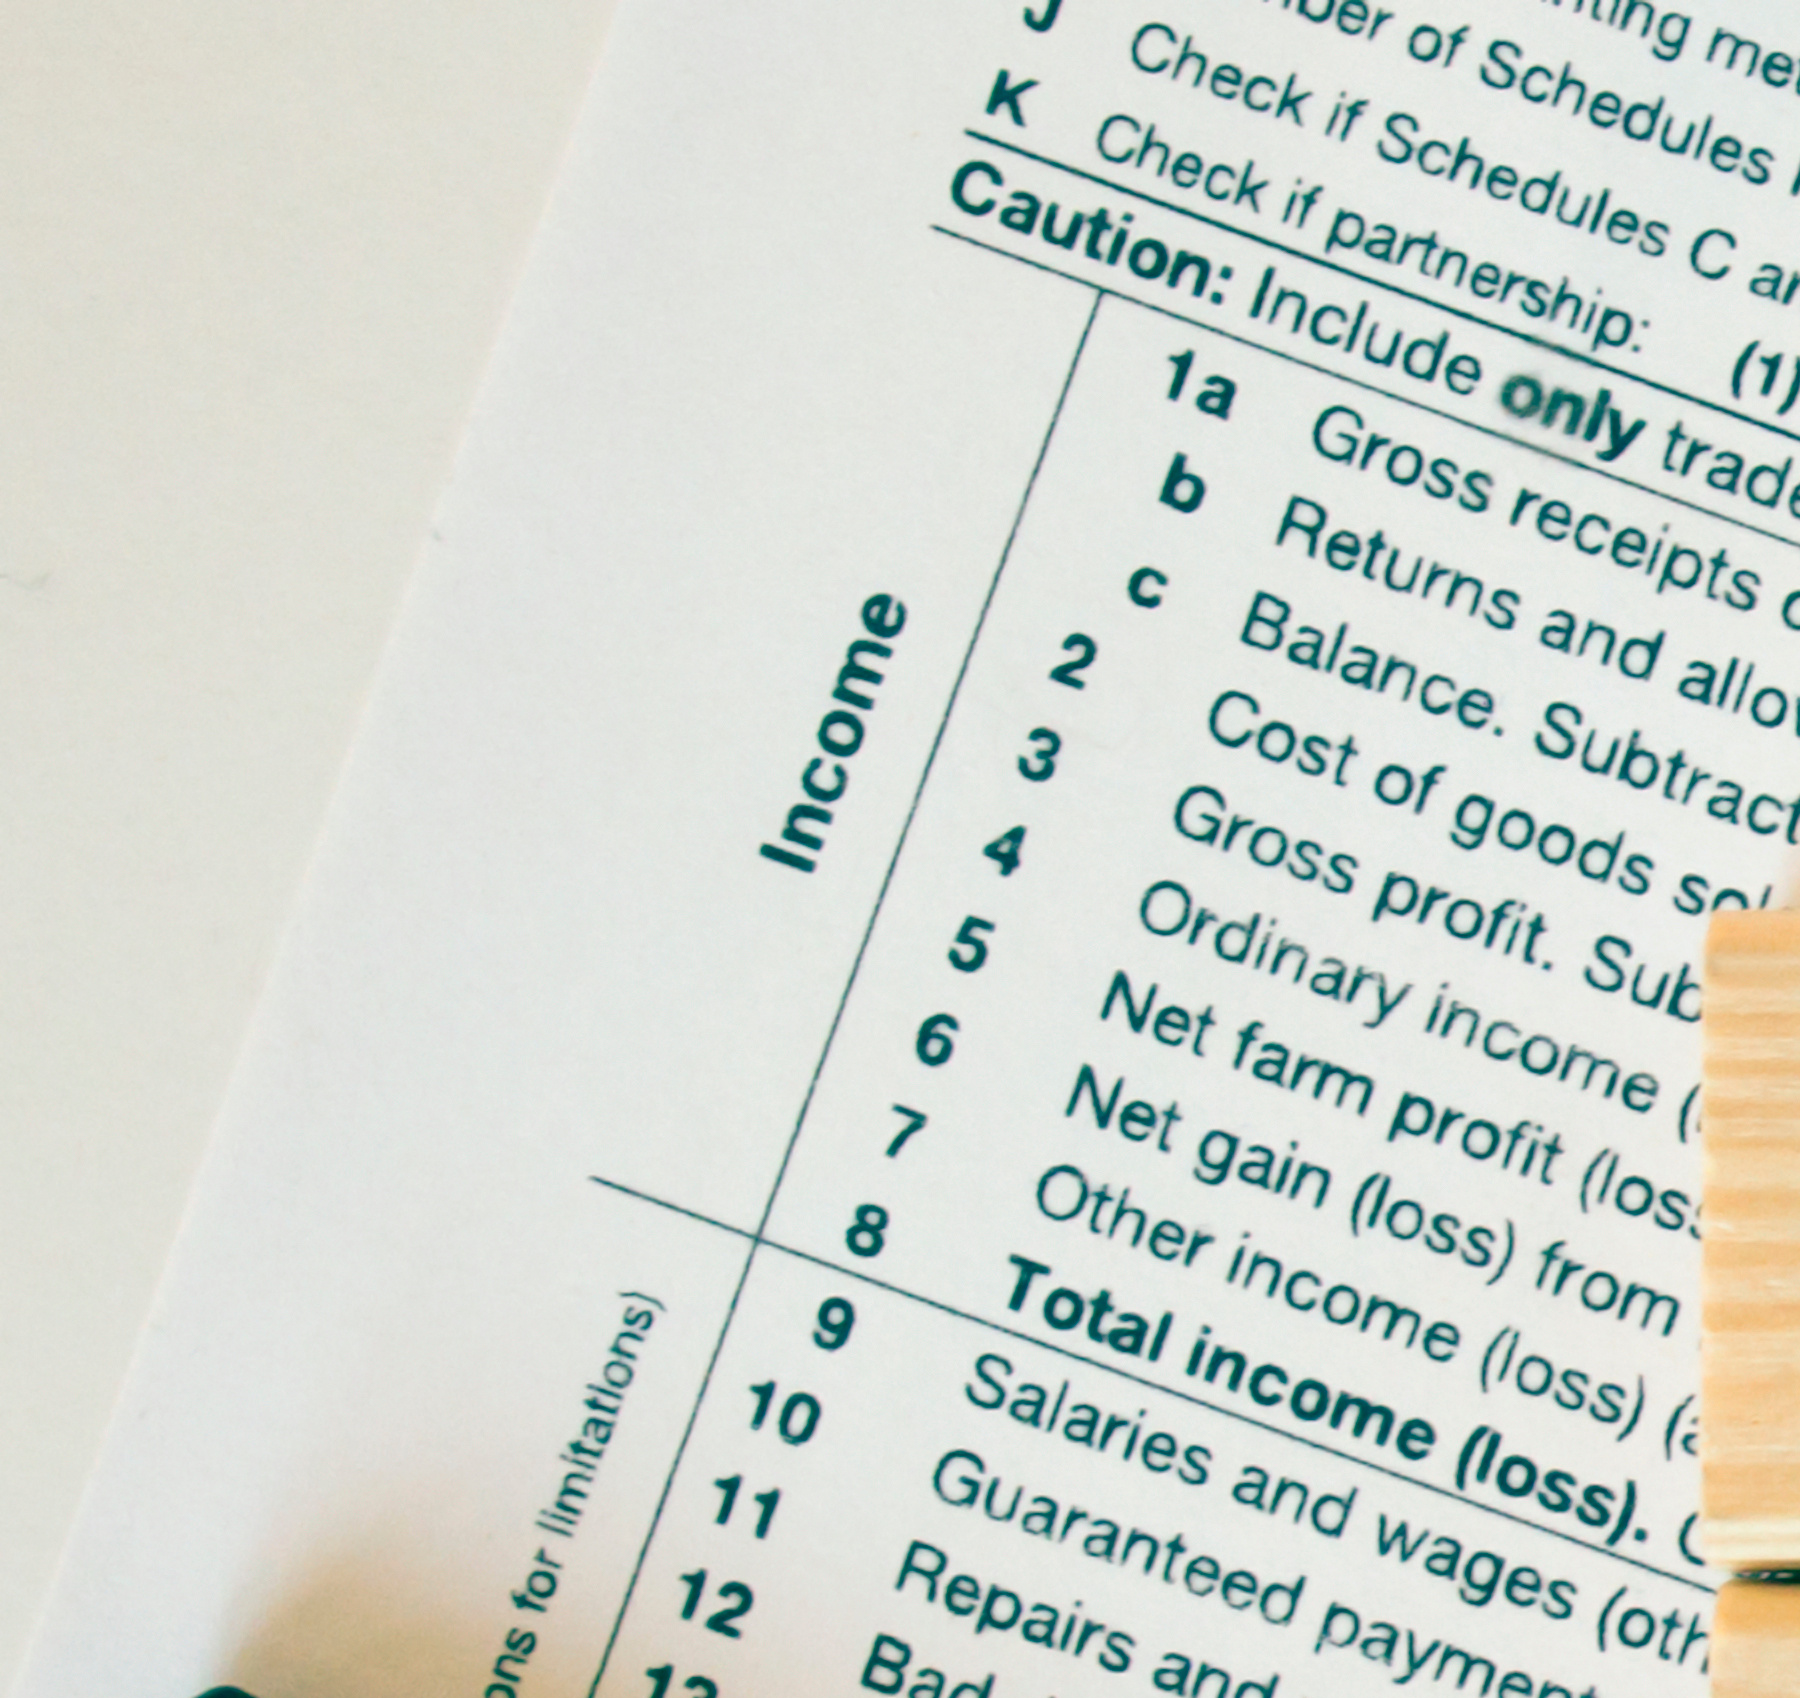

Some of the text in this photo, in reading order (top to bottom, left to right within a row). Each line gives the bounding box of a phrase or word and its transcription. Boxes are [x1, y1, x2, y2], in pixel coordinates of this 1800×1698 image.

[983, 67, 1642, 354] K Check if partnership:
[1406, 22, 1472, 69] of
[1478, 38, 1776, 187] Schedules
[948, 158, 1235, 307] Caution:
[1247, 264, 1483, 397] Include
[1497, 372, 1649, 464] only
[1157, 450, 1208, 516] b
[1274, 493, 1522, 632] Returns
[1538, 607, 1667, 683] and
[1165, 347, 1239, 422] 1a
[1310, 403, 1495, 515] Gross
[1508, 486, 1763, 614] receipts
[757, 591, 909, 875] Income
[508, 1289, 666, 1614] for limitations)
[747, 1378, 823, 1448] 10
[930, 1447, 1308, 1628] Guaranteed
[843, 1202, 1649, 1550] 8 Total income (loss).
[678, 1567, 756, 1641] 12
